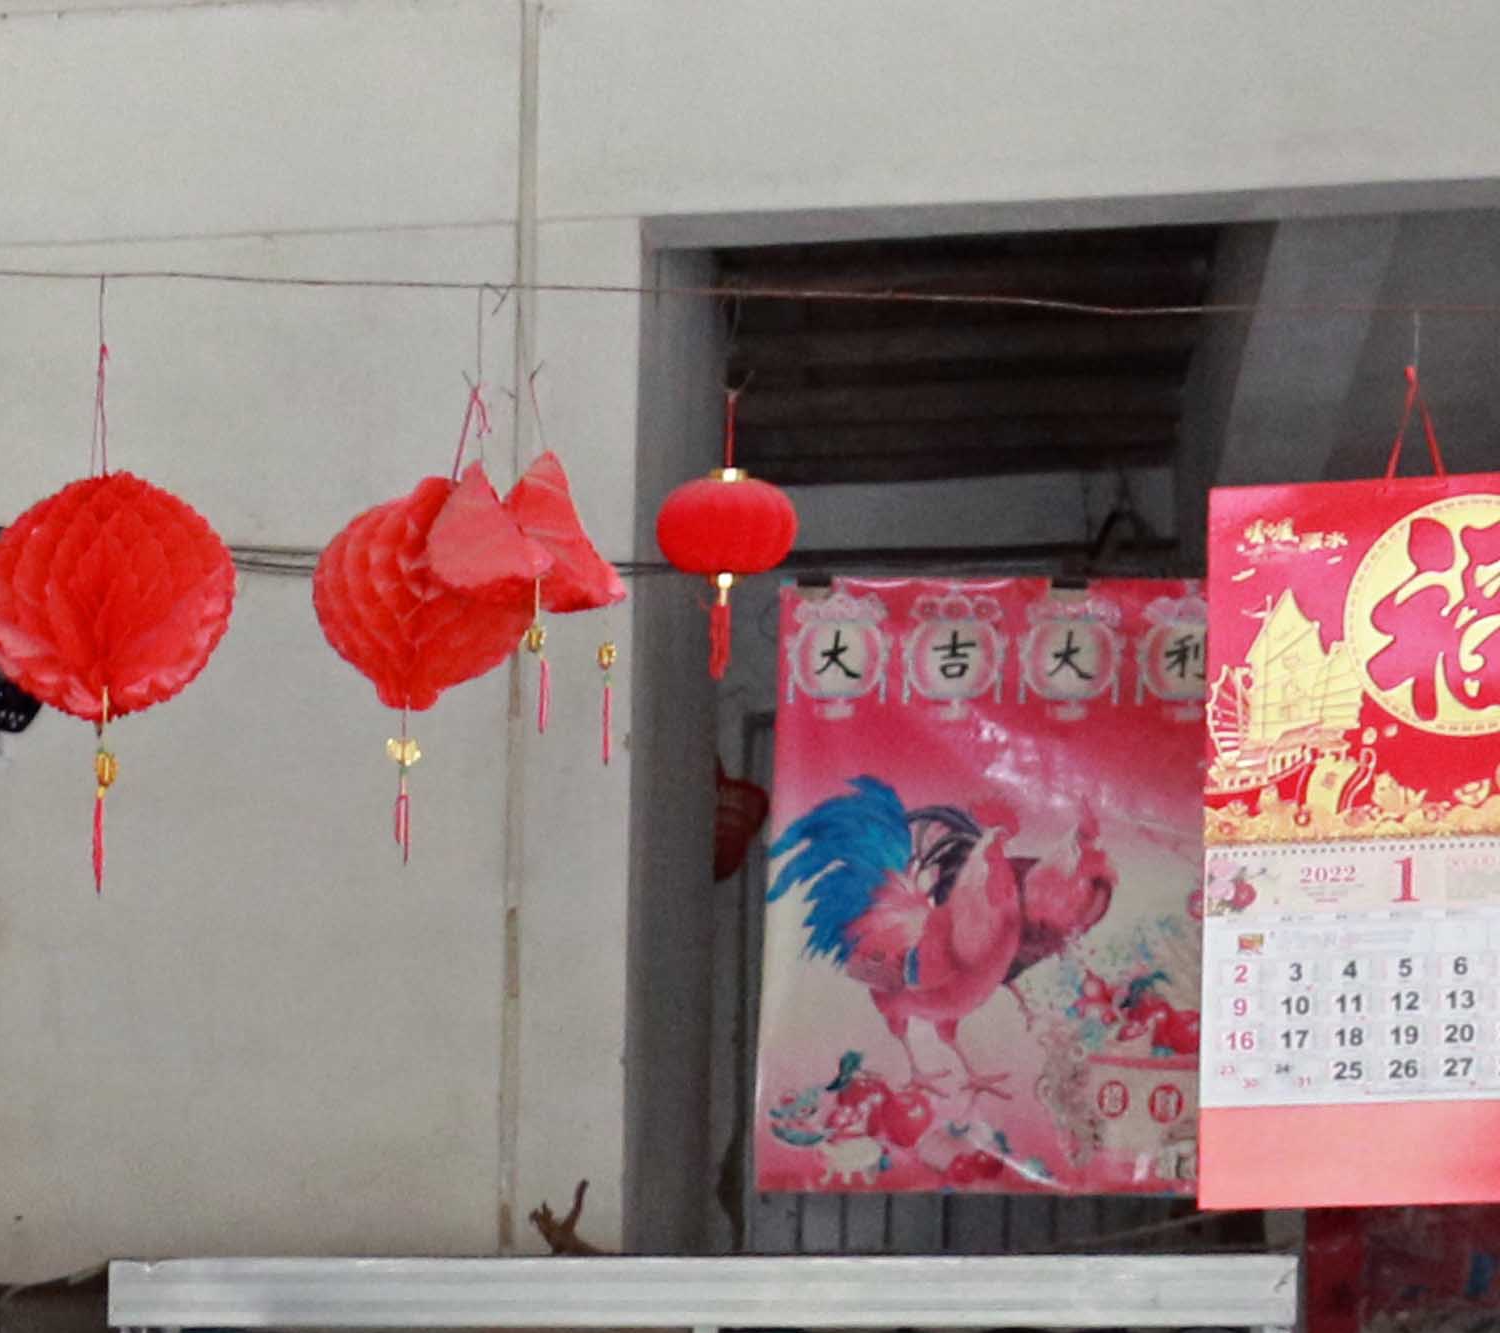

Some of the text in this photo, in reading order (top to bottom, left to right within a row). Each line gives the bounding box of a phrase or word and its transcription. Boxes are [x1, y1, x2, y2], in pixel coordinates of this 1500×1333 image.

[1299, 857, 1420, 903] 2022 1
[1234, 956, 1468, 984] 2 3 4 5 6
[1232, 990, 1475, 1018] 9 10 11 12 13
[1226, 1024, 1474, 1050] 16 17 18 19 20
[1333, 1061, 1363, 1080] 25
[1389, 1059, 1418, 1078] 26
[1443, 1057, 1473, 1077] 27
